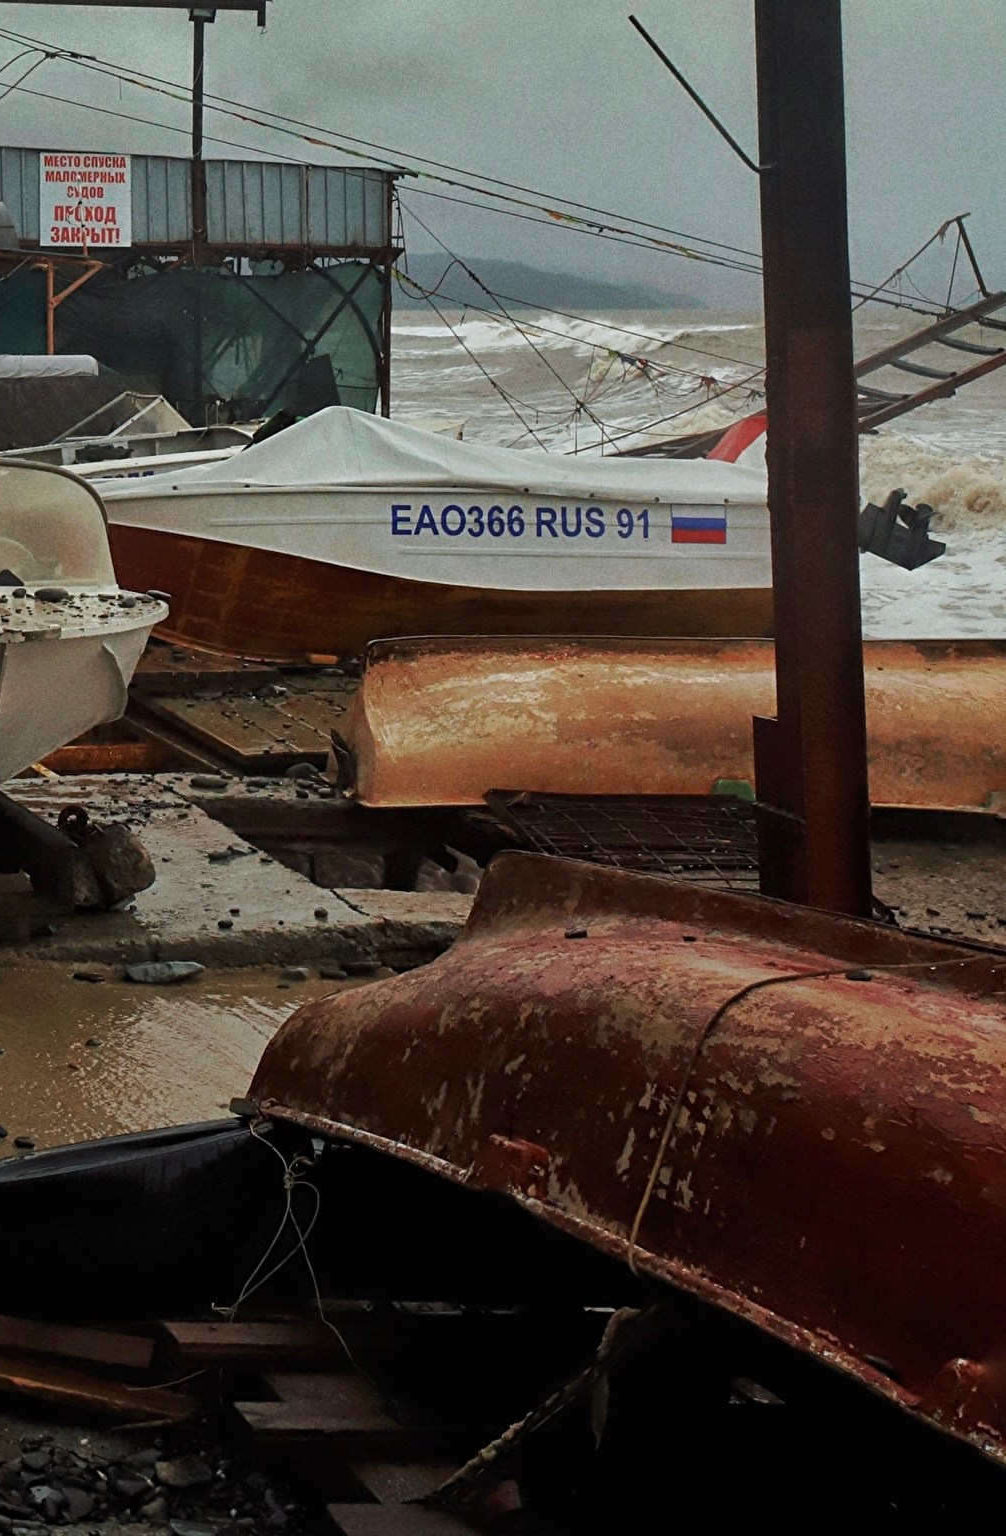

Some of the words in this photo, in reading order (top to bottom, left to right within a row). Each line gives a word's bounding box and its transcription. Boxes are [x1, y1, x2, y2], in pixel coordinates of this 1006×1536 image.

[44, 155, 81, 168] МЕСТО
[83, 155, 127, 169] СПУСКА
[45, 171, 126, 184] МАЛОМЕРНЫХ
[54, 205, 117, 225] ПРОХОД
[535, 506, 606, 538] RUS
[616, 508, 650, 539] 91
